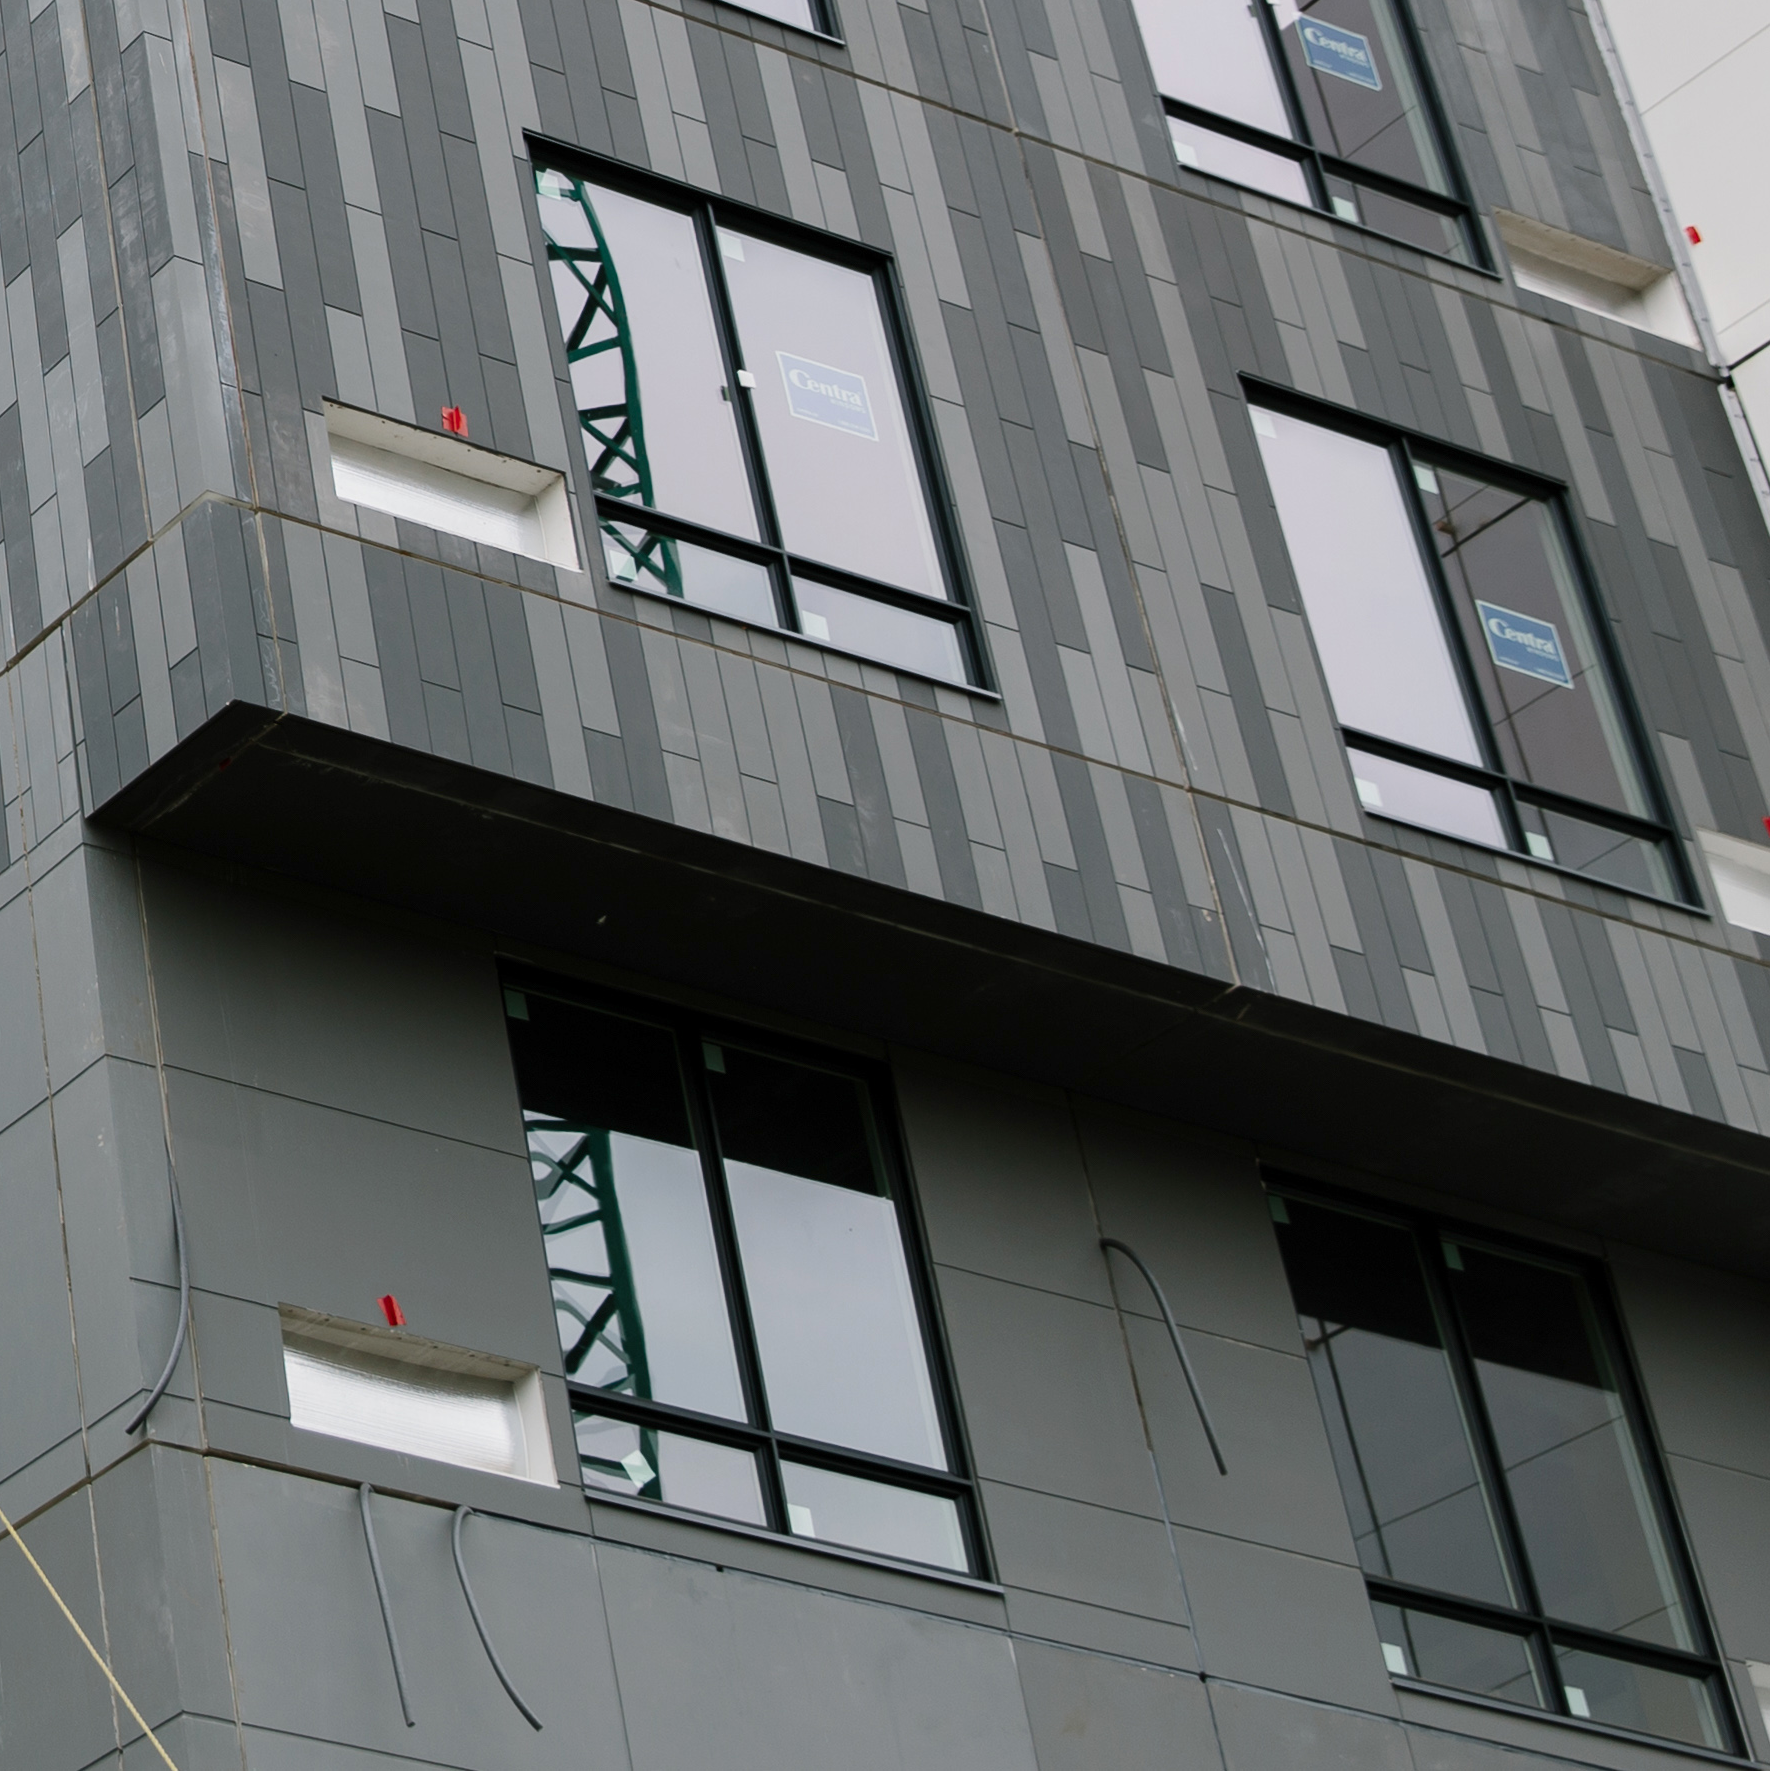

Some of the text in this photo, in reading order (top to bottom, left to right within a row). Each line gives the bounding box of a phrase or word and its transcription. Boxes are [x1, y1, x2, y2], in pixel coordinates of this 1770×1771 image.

[1304, 27, 1367, 63] Centra
[788, 368, 863, 407] Centra
[1488, 618, 1557, 655] Centra
